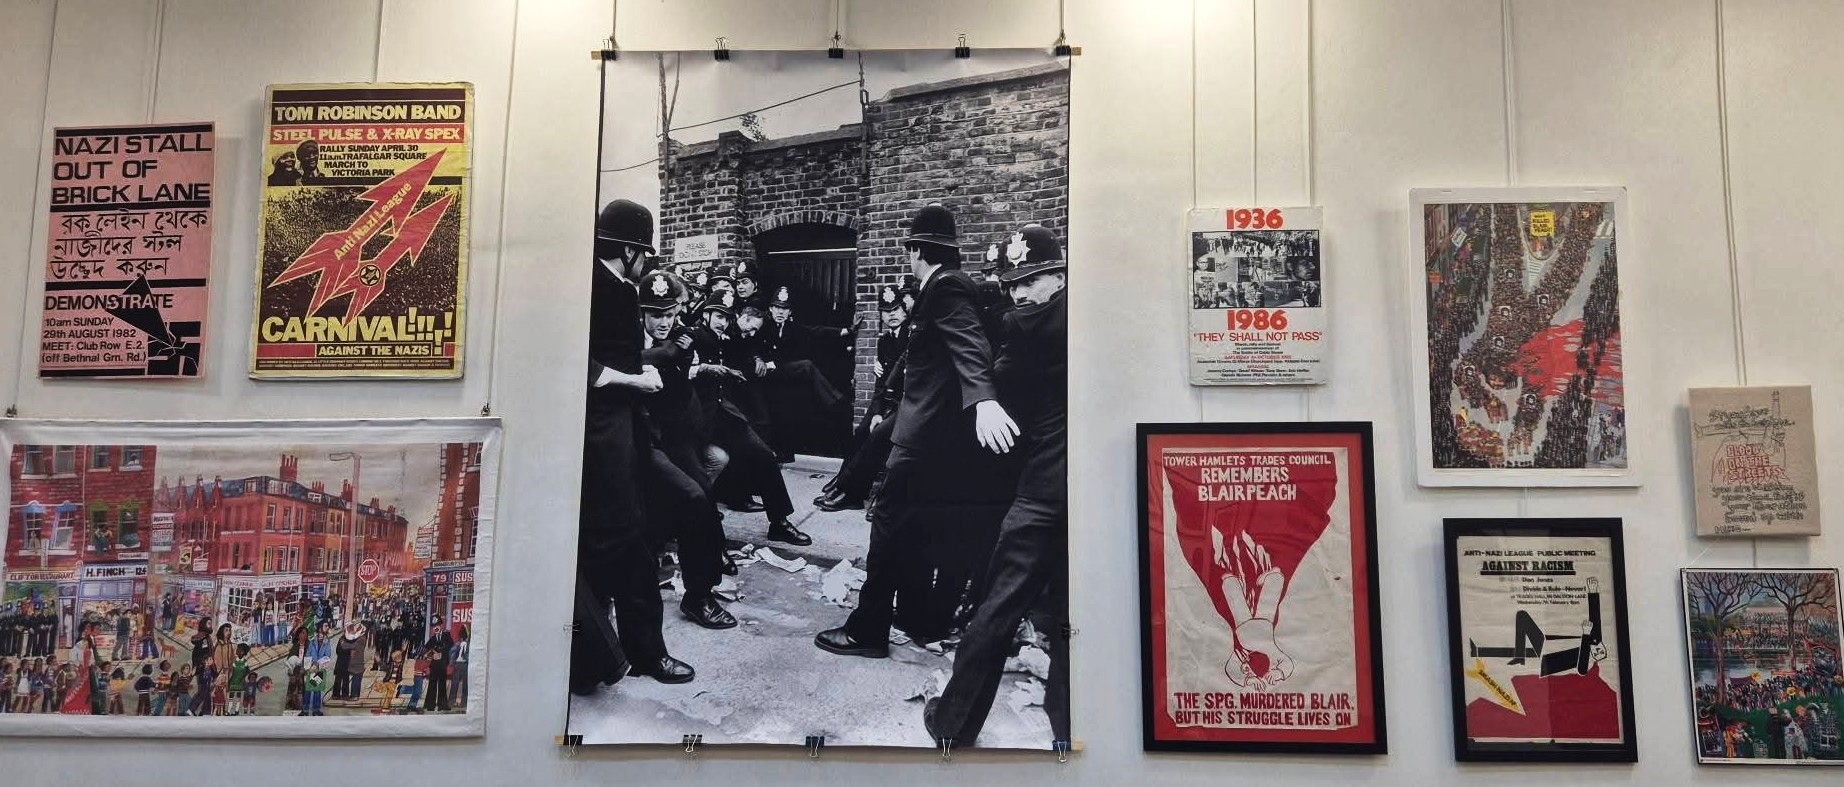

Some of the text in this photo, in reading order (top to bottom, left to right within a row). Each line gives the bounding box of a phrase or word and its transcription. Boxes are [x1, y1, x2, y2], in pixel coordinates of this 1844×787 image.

[275, 104, 461, 121] TOM ROBINSON BAND
[273, 128, 460, 142] STEEL PULSE & X-RAY SPEX
[55, 134, 212, 155] NAZI STALL
[53, 160, 158, 180] OUT OF
[324, 161, 368, 169] MARCH TO
[52, 183, 211, 204] BRICK LANE
[155, 210, 208, 230] থেকে
[334, 183, 412, 260] Anti Nazi League
[1226, 208, 1284, 230] 1936
[116, 257, 170, 277] করুন
[45, 294, 174, 311] DEMONSTRATE
[46, 317, 114, 327] 10am SUNDAY
[1227, 309, 1288, 331] 1986
[43, 329, 136, 338] 29th AUGUST 1982
[1194, 331, 1323, 342] "THEY SHALL NOT PASS"
[42, 340, 145, 350] MEET: Club Row E.2.
[318, 345, 430, 356] AGAINST THE NAZIS
[41, 354, 60, 363] (off
[63, 353, 100, 362] Bethnal
[126, 352, 147, 362] Rd.)
[1163, 454, 1332, 467] TOWER HAMLETS TRADES COUNCIL
[1201, 467, 1289, 484] REMEMBERS
[1198, 484, 1297, 501] BLAIR PEACH
[97, 567, 125, 577] FINCH
[360, 564, 377, 576] STOP
[1482, 561, 1574, 571] AGAINST RACISM
[432, 574, 447, 583] 79
[1174, 692, 1200, 709] THE
[1240, 692, 1305, 710] MURDERED
[1175, 711, 1351, 726] BUT HIS STRUGGLE LIVES ON
